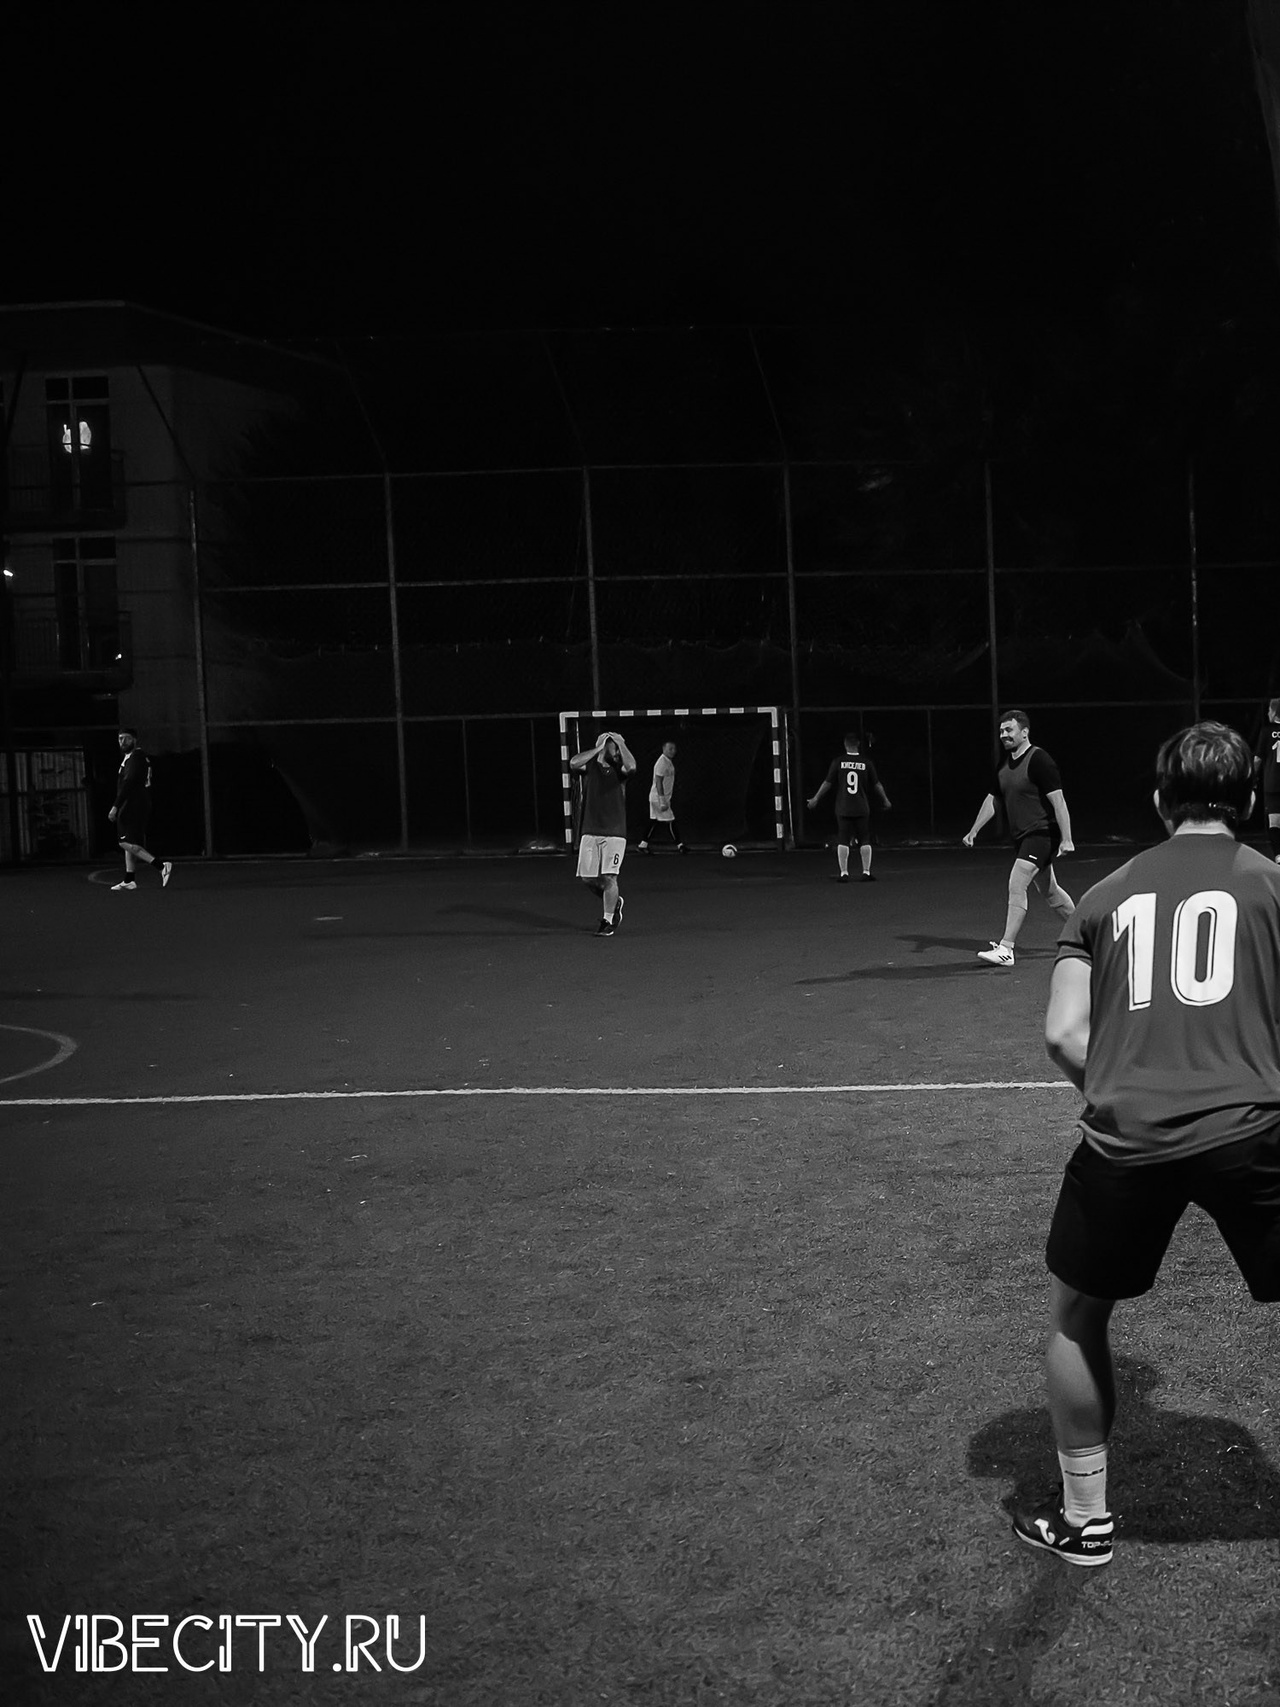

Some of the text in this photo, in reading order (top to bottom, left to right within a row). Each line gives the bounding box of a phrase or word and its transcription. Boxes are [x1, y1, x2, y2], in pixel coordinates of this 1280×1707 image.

[846, 771, 858, 795] 9
[613, 853, 620, 865] 6
[1111, 889, 1239, 1012] 10
